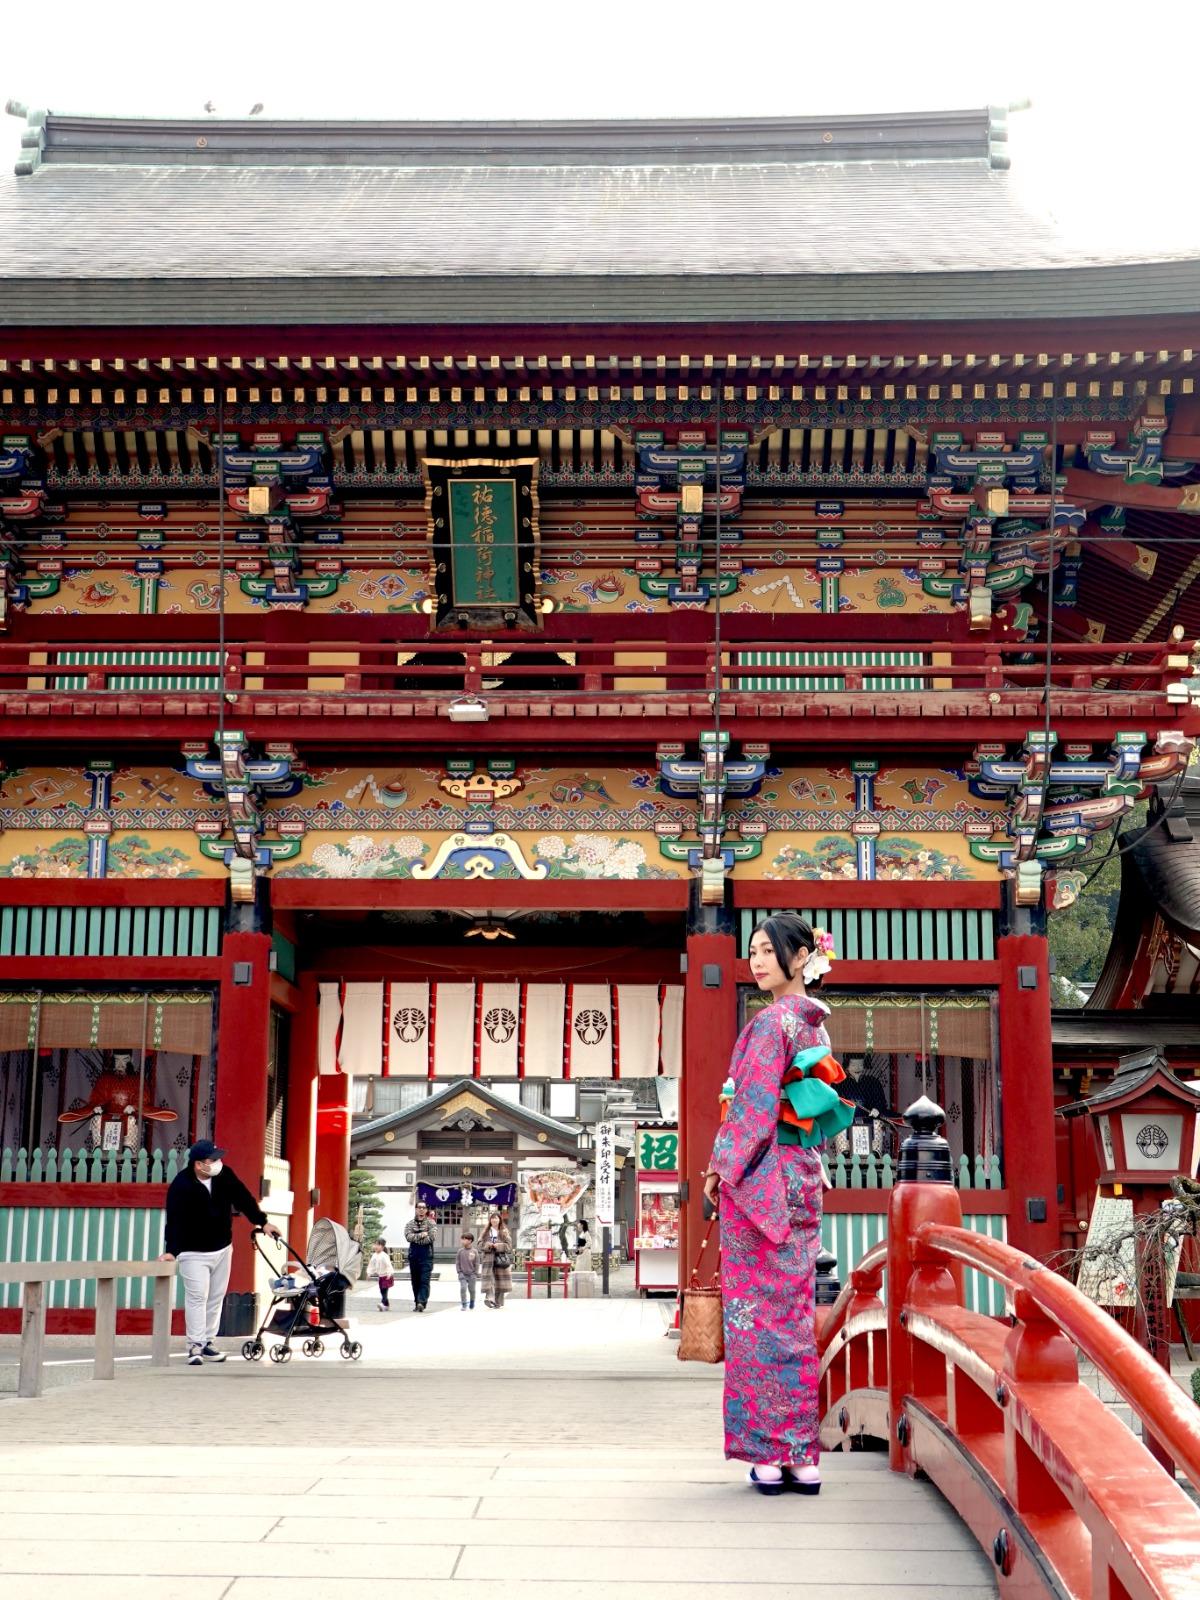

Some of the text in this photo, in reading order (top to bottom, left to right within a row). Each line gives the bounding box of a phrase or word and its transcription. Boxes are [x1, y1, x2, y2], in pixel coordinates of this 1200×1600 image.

[600, 1125, 611, 1184] 御朱印受付
[640, 1133, 678, 1169] 招
